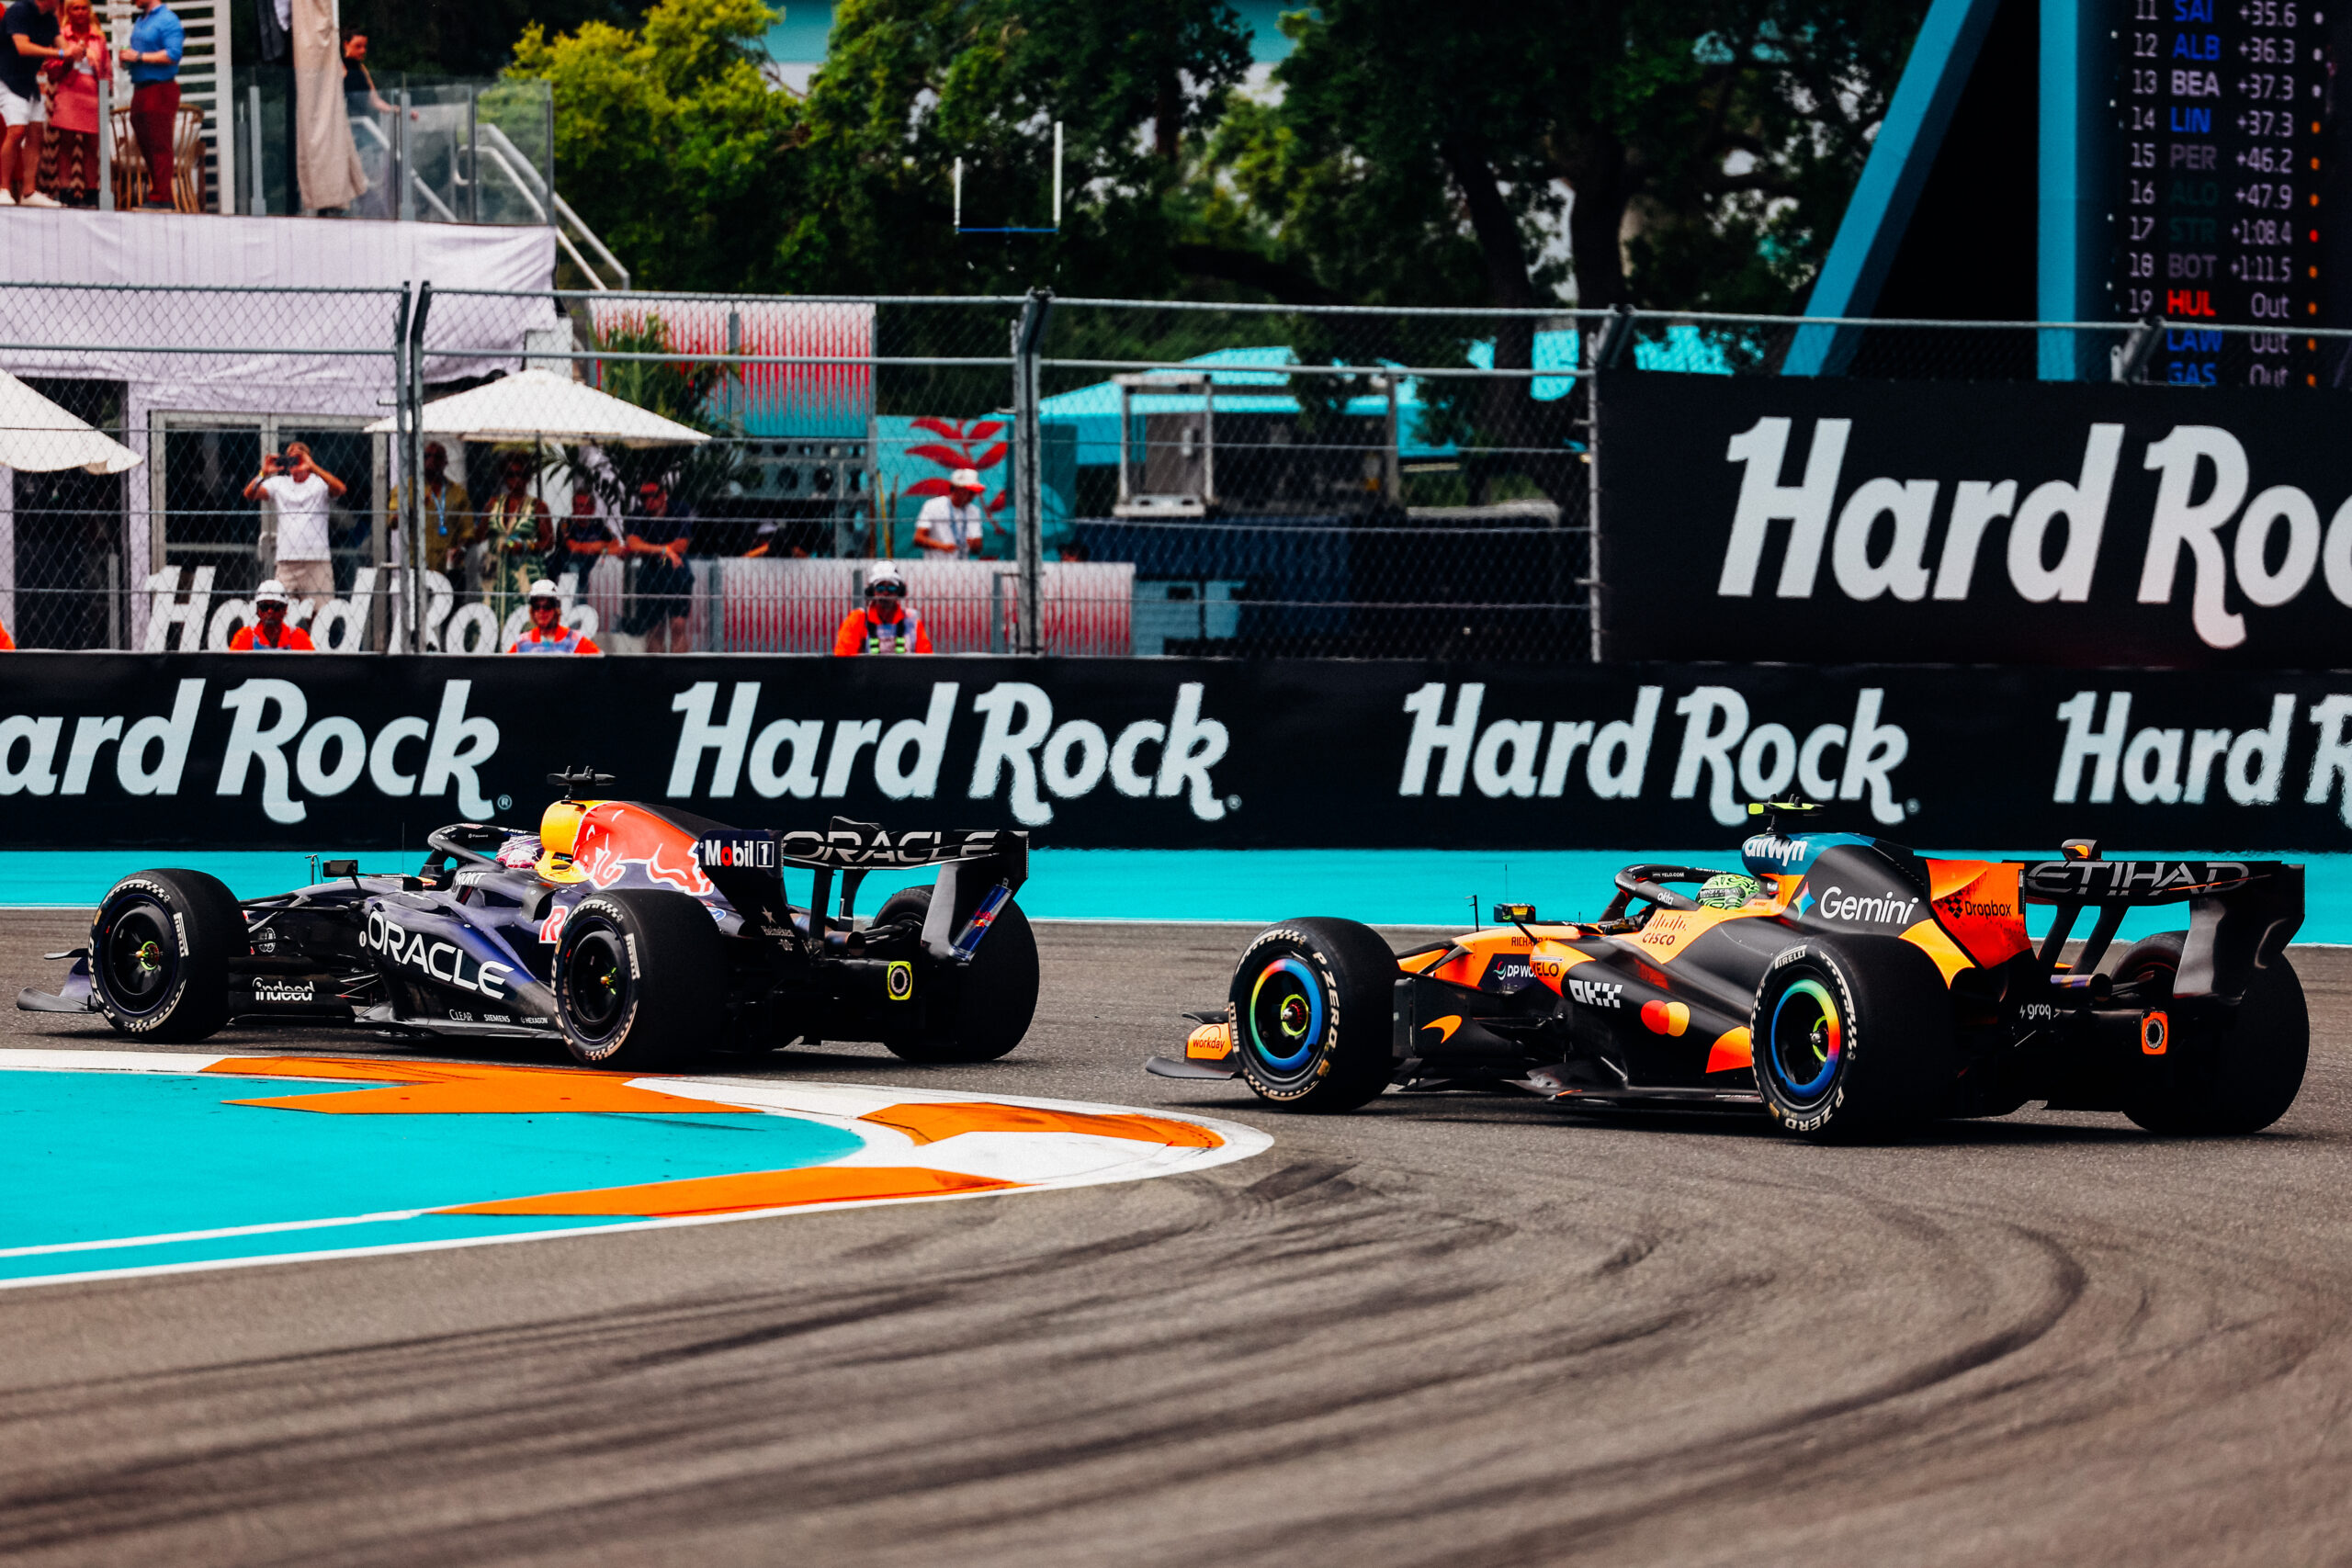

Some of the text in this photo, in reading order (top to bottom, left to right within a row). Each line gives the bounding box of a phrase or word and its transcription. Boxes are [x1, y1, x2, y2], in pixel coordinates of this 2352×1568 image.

[2135, 0, 2297, 28] 11 SAI +35.6
[2133, 33, 2295, 64] 12 ALB +36.3
[2132, 69, 2294, 101] 13 BEA +37.3
[2132, 106, 2294, 137] 14 LIN +37.3
[2132, 142, 2293, 175] 15 PER +46.2
[2131, 180, 2155, 205] 16
[2235, 184, 2293, 210] +47.9
[2130, 217, 2155, 241] 17
[2129, 253, 2154, 277] 18
[2168, 254, 2218, 278] BOT
[2129, 288, 2290, 319] 19 HUL Out
[2166, 328, 2223, 353] LAW
[2167, 362, 2217, 386] GAS
[1717, 415, 2125, 603] Hard
[216, 678, 501, 825] Rock
[667, 682, 1230, 826] Hard Rock
[1398, 682, 1909, 827] Hard Rock
[2052, 691, 2297, 807] Hard
[705, 840, 754, 867] Mobil
[783, 830, 999, 863] ORACLE
[2027, 861, 2250, 897] ETIHAD
[1657, 891, 1675, 906] okta
[1820, 886, 1920, 925] Gemini
[1964, 898, 2012, 918] Dropbox
[368, 909, 515, 1000] ORACLE
[1511, 937, 1544, 947] RICHA
[1774, 944, 1808, 970] PIRELLI
[1507, 965, 1519, 977] DP
[253, 977, 316, 1001] indeed
[1312, 952, 1340, 1049] P ZERO
[1568, 979, 1623, 1009] OKX
[449, 1010, 473, 1021] CLEAR
[483, 1014, 511, 1022] SIEMENS
[2027, 1003, 2052, 1020] groq
[1193, 1036, 1226, 1052] workday
